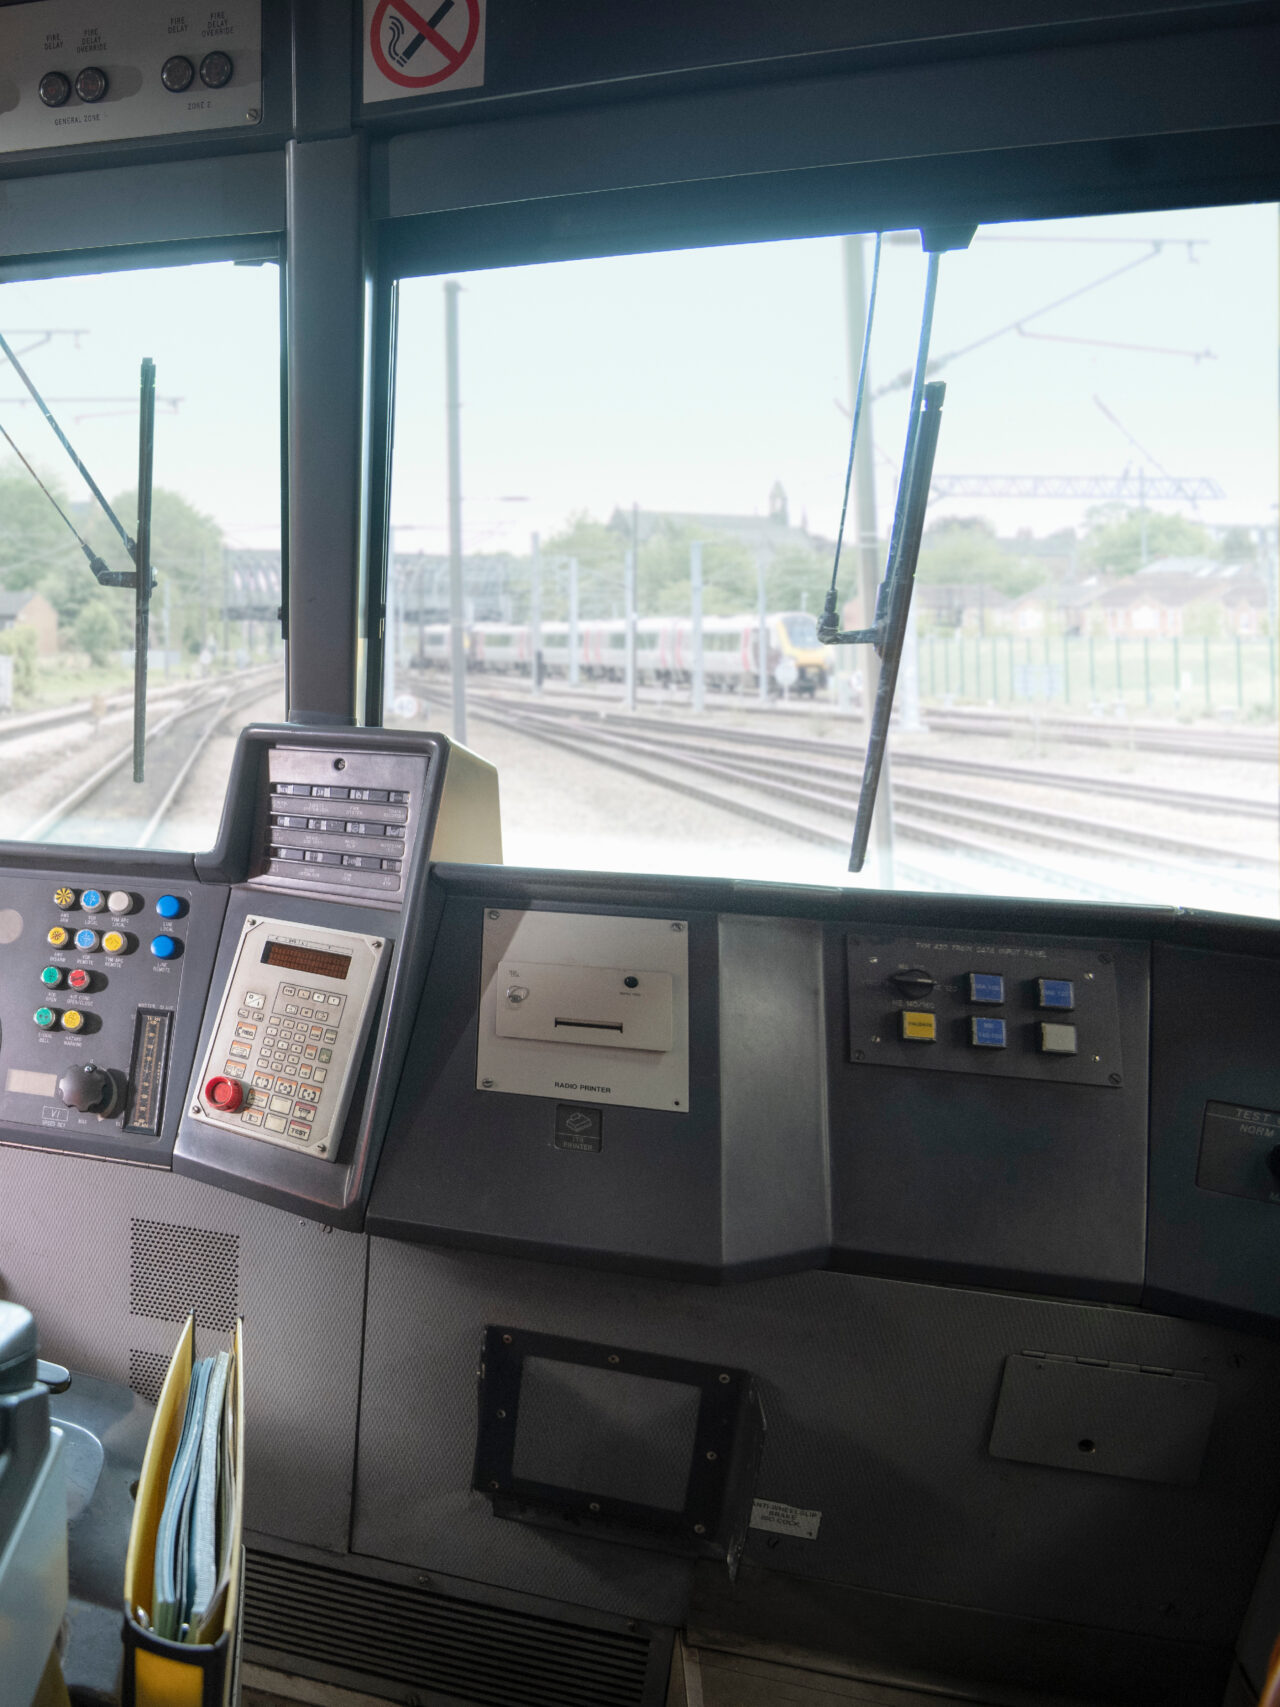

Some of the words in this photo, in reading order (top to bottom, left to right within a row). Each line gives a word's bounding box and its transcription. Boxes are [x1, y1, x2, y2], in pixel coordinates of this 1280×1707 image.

[211, 11, 225, 19] FIRE
[171, 17, 185, 25] FIRE
[208, 19, 228, 28] DELAY
[83, 28, 98, 36] FIRE
[167, 25, 189, 34] DELAY
[201, 26, 235, 38] OVERRIDE
[46, 33, 60, 41] FIRE
[81, 36, 102, 45] DELAY
[44, 40, 64, 50] DELAY
[76, 42, 108, 54] OVERRIDE
[187, 101, 205, 110] ZONE
[54, 117, 82, 126] GENERAL
[84, 114, 101, 123] ZONE
[916, 941, 930, 950] TVM
[952, 945, 973, 954] TRAIN
[976, 947, 995, 955] DATA
[998, 949, 1021, 957] INPUT
[1024, 951, 1048, 959] PANEL
[554, 1082, 578, 1090] RADIO
[580, 1084, 611, 1094] PRINTER
[1236, 1108, 1270, 1122] TEST
[291, 1128, 307, 1138] TEST
[1240, 1124, 1274, 1136] NORM
[563, 1142, 593, 1151] PRINTER
